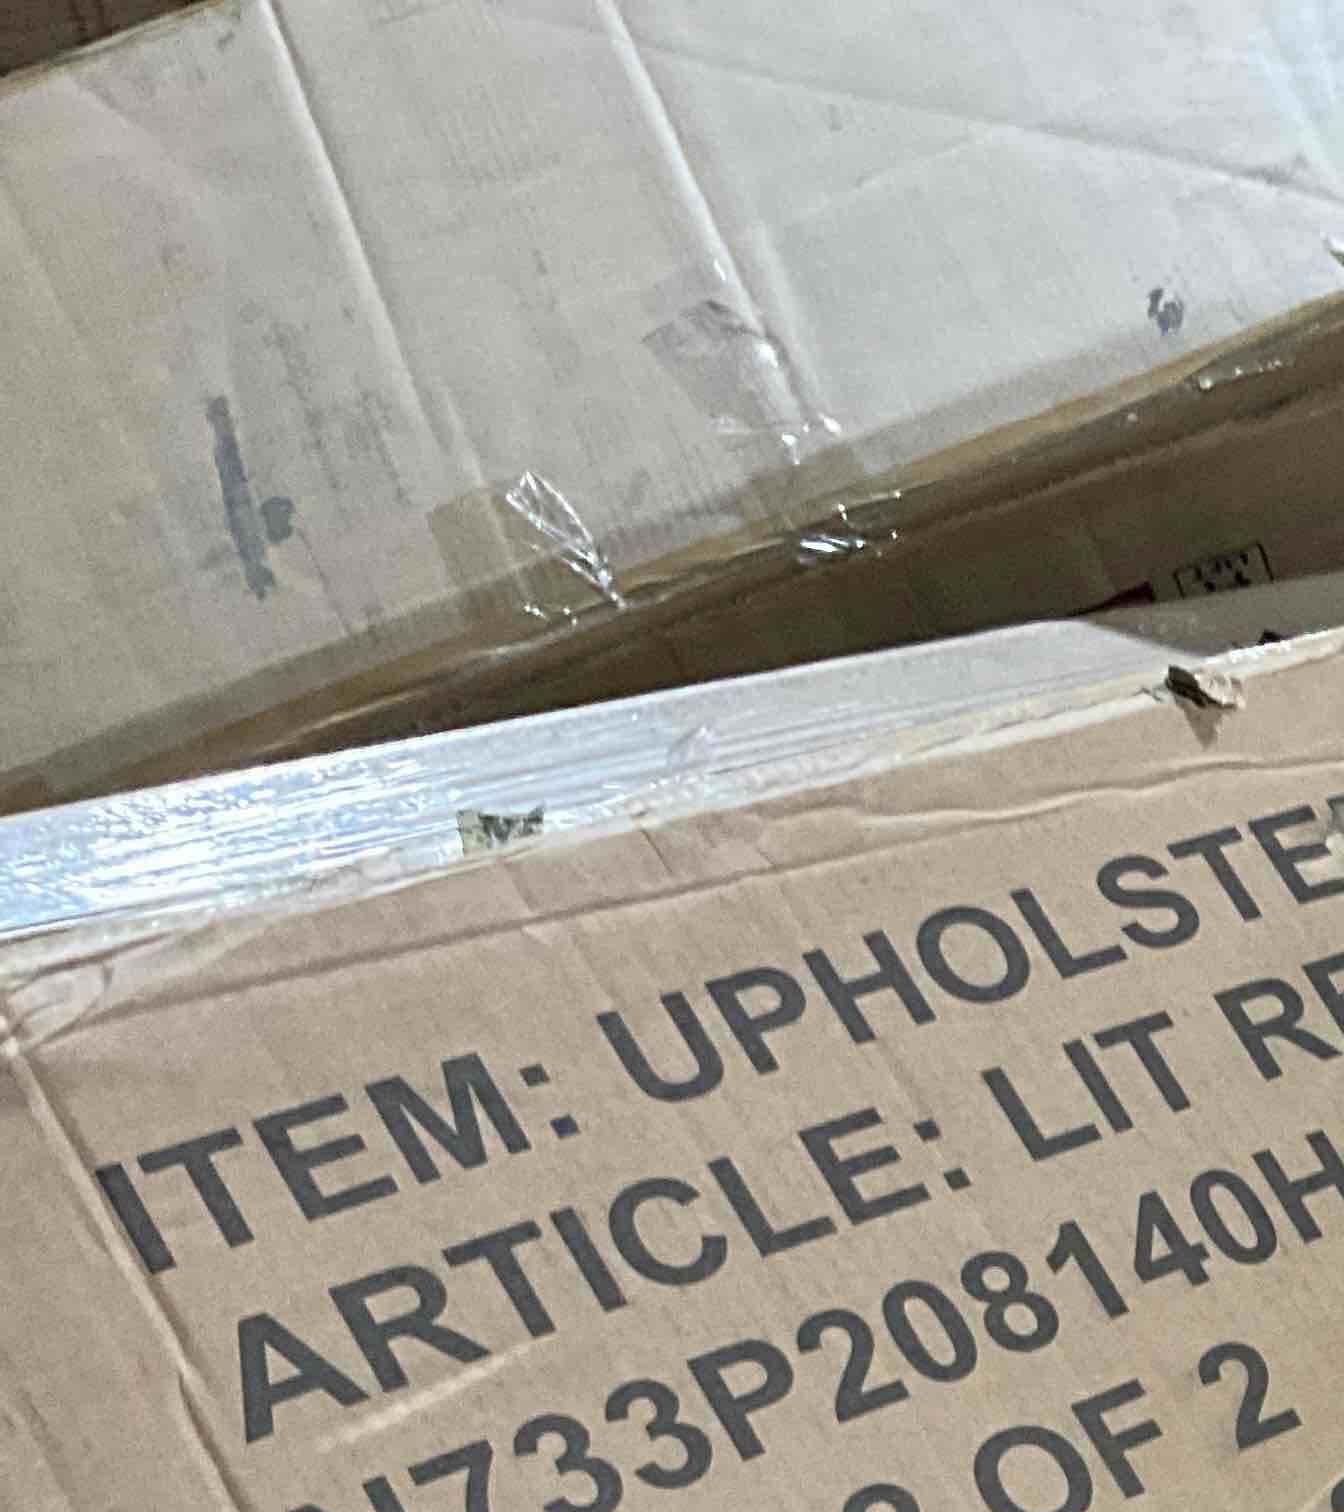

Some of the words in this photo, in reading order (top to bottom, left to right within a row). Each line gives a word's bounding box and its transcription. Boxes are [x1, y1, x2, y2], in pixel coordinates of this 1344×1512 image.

[95, 1052, 578, 1273] ITEM:
[235, 1107, 972, 1443] ARTICLE:
[982, 1011, 1192, 1163] LIT
[1199, 1342, 1302, 1450] 2
